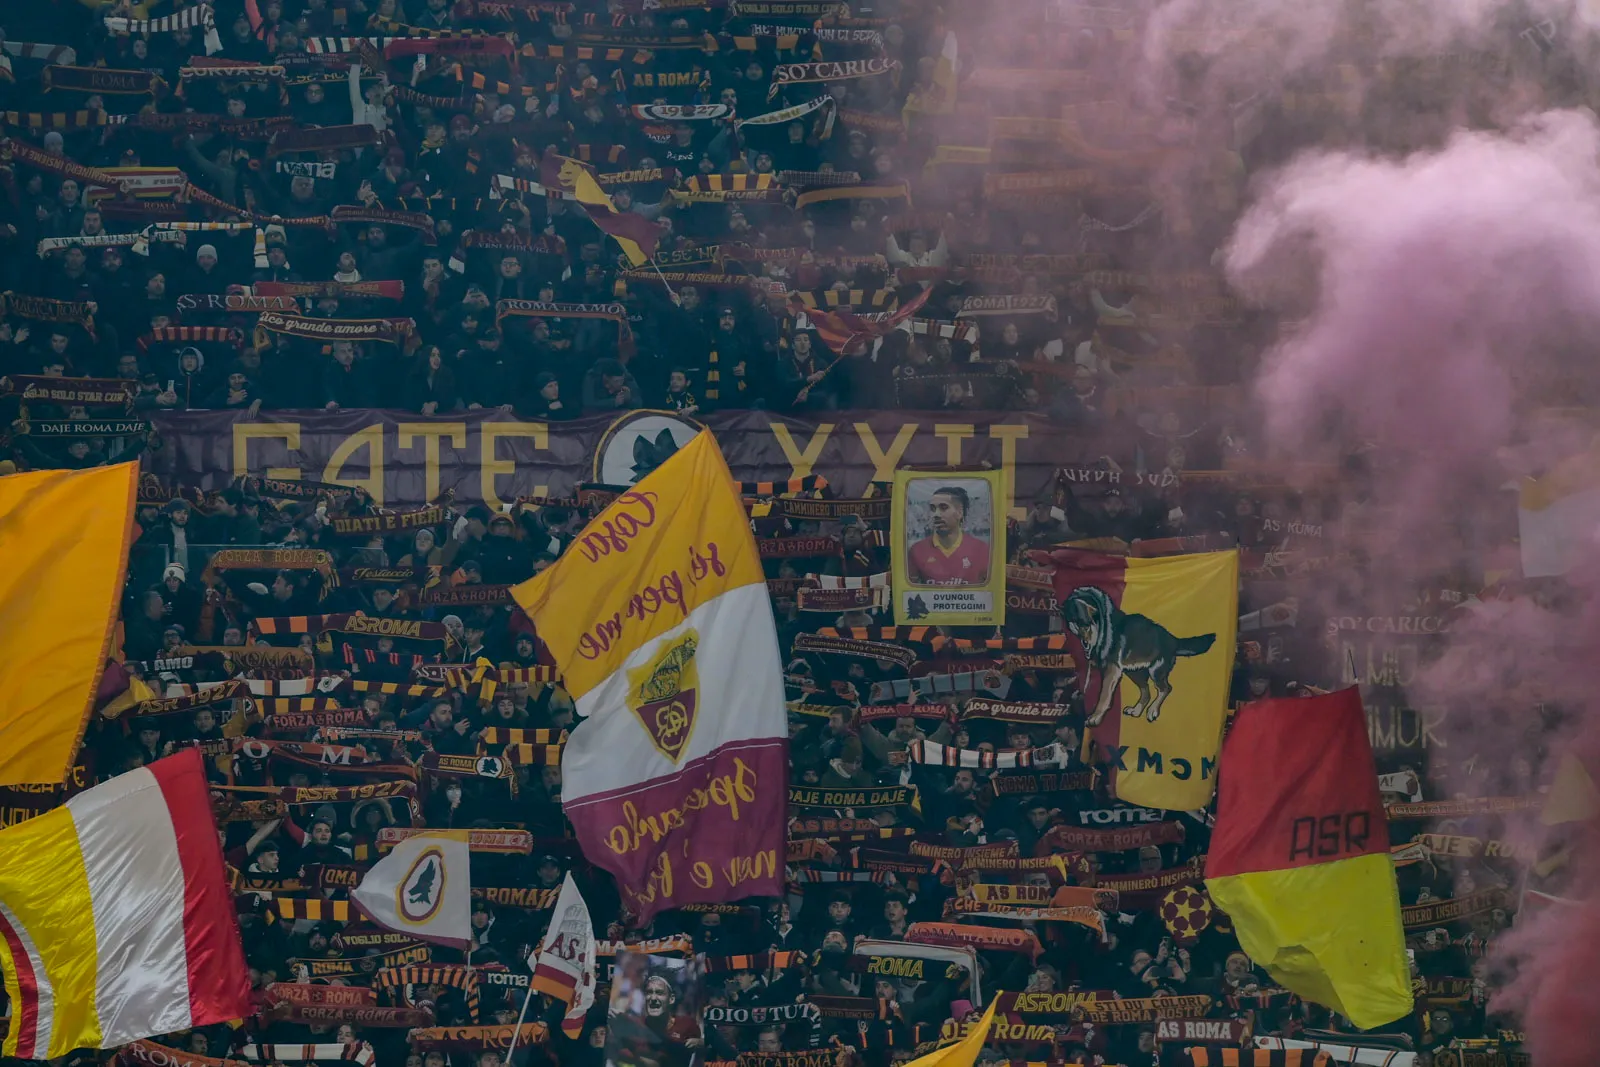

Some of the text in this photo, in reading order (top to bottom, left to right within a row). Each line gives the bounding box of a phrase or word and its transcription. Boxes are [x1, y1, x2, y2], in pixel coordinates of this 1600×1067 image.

[92, 72, 136, 89] ROMA
[657, 71, 699, 88] ROMA
[207, 294, 284, 310] ROMA
[508, 300, 558, 312] ROMA
[573, 302, 621, 315] AMO
[285, 317, 377, 335] grande amore
[51, 389, 76, 400] SOLO
[77, 391, 102, 402] STAR
[41, 422, 146, 434] DAJE ROMA DAJE
[264, 480, 304, 496] FORZA
[783, 500, 830, 515] CAMMINERO
[833, 502, 865, 517] INSIEME
[385, 515, 396, 527] E
[797, 538, 835, 551] ROMA
[933, 593, 976, 601] OVUNQUE
[933, 602, 987, 611] PROTEGGIMI
[153, 655, 194, 671] AMO
[138, 680, 241, 714] ASR 1927
[861, 703, 947, 717] ROMA ROMA
[990, 704, 1040, 717] grande
[272, 711, 364, 728] FORZA ROMA
[438, 756, 473, 768] AS ROMA
[295, 779, 408, 801] ASR 1927
[823, 790, 866, 804] ROMA
[870, 789, 906, 803] DAJE
[1113, 829, 1152, 846] ROMA
[1289, 811, 1369, 862] ASR
[963, 845, 1006, 859] INSIEME
[486, 887, 537, 907] ROMA
[986, 885, 1010, 900] AS
[954, 897, 982, 912] CHE
[343, 934, 382, 946] VOGLIO
[311, 961, 354, 976] ROMA
[867, 954, 924, 978] ROMA
[487, 971, 529, 987] roma
[325, 988, 363, 1005] ROMA
[300, 1006, 396, 1022] FORZA ROMA
[1094, 1001, 1119, 1012] STI
[1091, 1008, 1152, 1023] DE ROMA
[994, 1022, 1057, 1041] ROMA
[1158, 1021, 1232, 1040] AS ROMA
